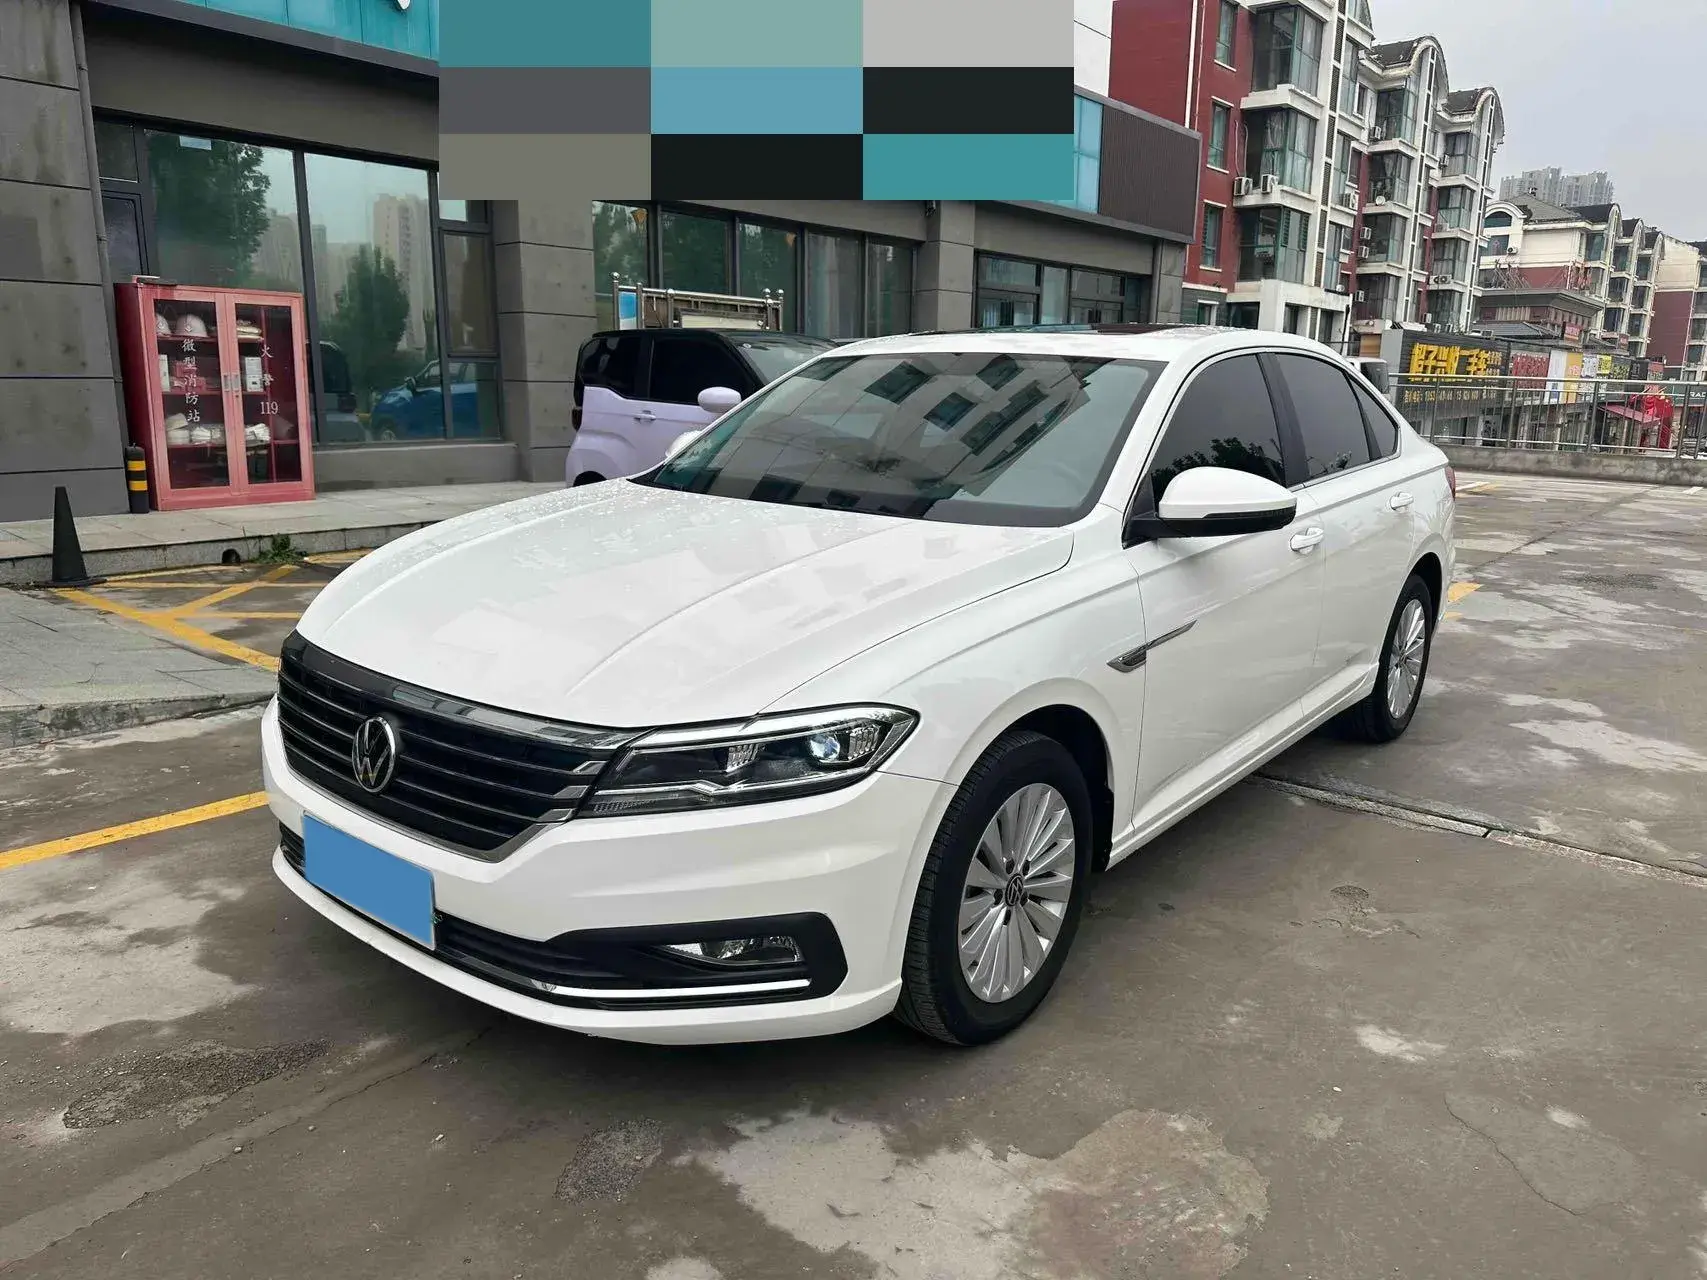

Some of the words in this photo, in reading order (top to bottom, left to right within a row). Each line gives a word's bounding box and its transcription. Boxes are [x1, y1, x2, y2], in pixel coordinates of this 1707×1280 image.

[182, 339, 200, 422] 微型消防站
[260, 401, 279, 415] 119
